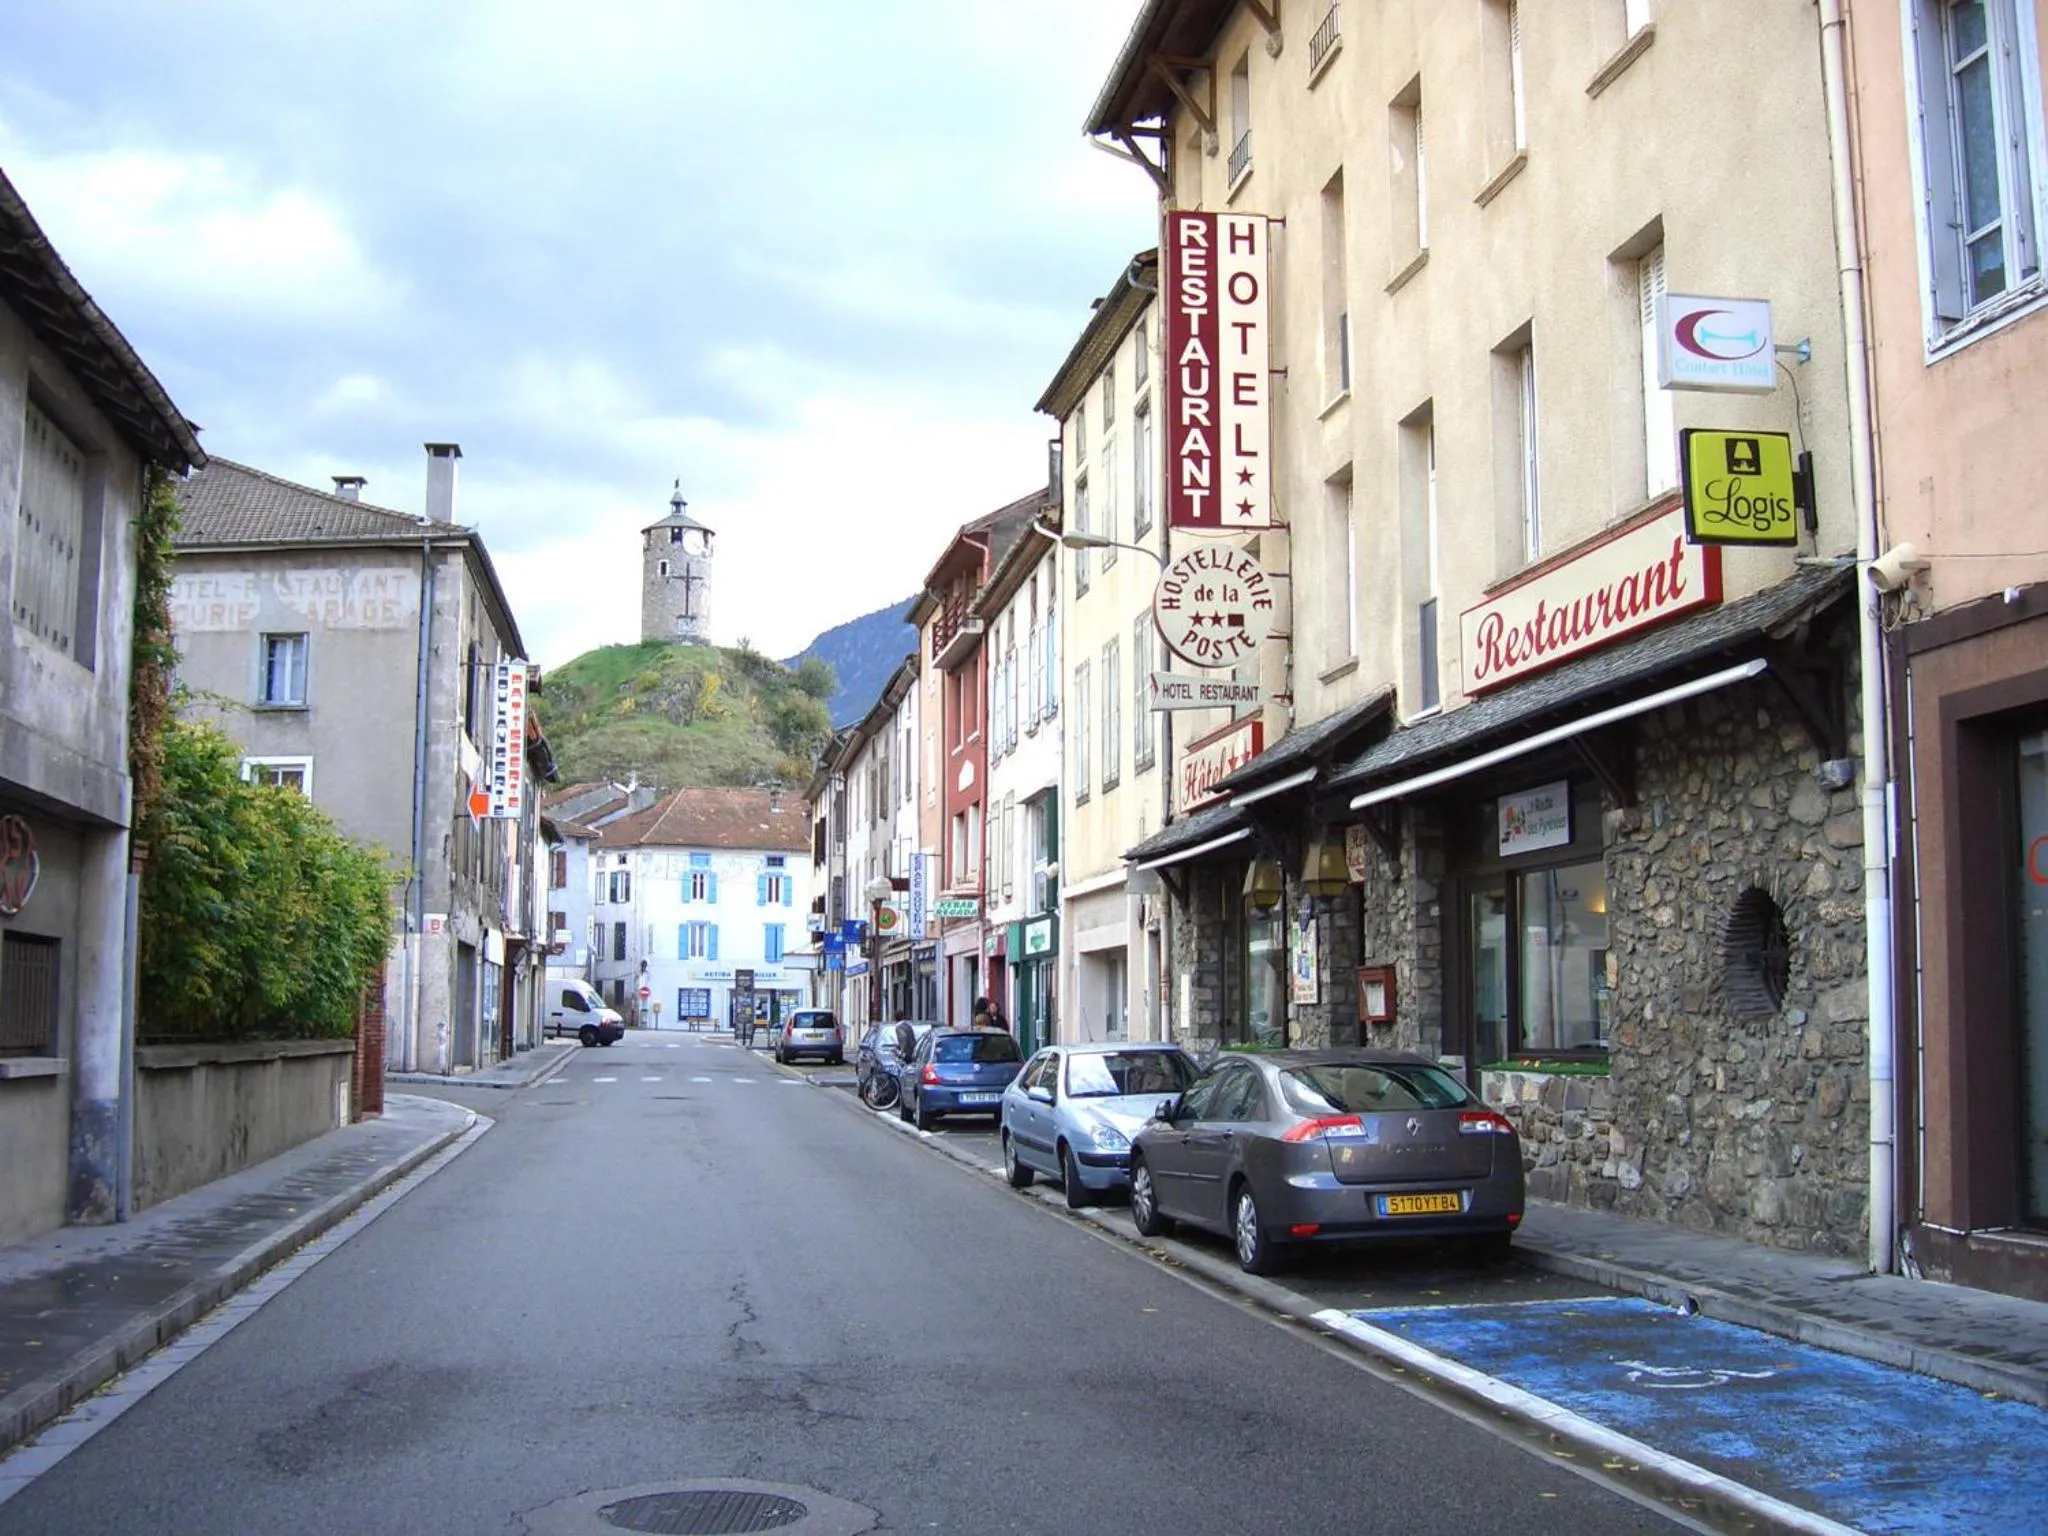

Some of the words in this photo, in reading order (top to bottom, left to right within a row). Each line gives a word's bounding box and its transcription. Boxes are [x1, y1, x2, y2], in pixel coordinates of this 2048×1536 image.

[1228, 222, 1258, 457] HOTEL
[1179, 219, 1211, 518] RESTAURANT
[1703, 477, 1791, 532] Logis
[1161, 548, 1273, 611] HOSTELLERIE
[1194, 583, 1214, 602] de
[1223, 584, 1239, 602] la
[1474, 535, 1687, 680] Restaurant
[1180, 628, 1257, 660] POSTE
[1162, 683, 1193, 700] HOTEL
[1200, 684, 1260, 701] RESTAURANT
[940, 900, 974, 909] KEBAB
